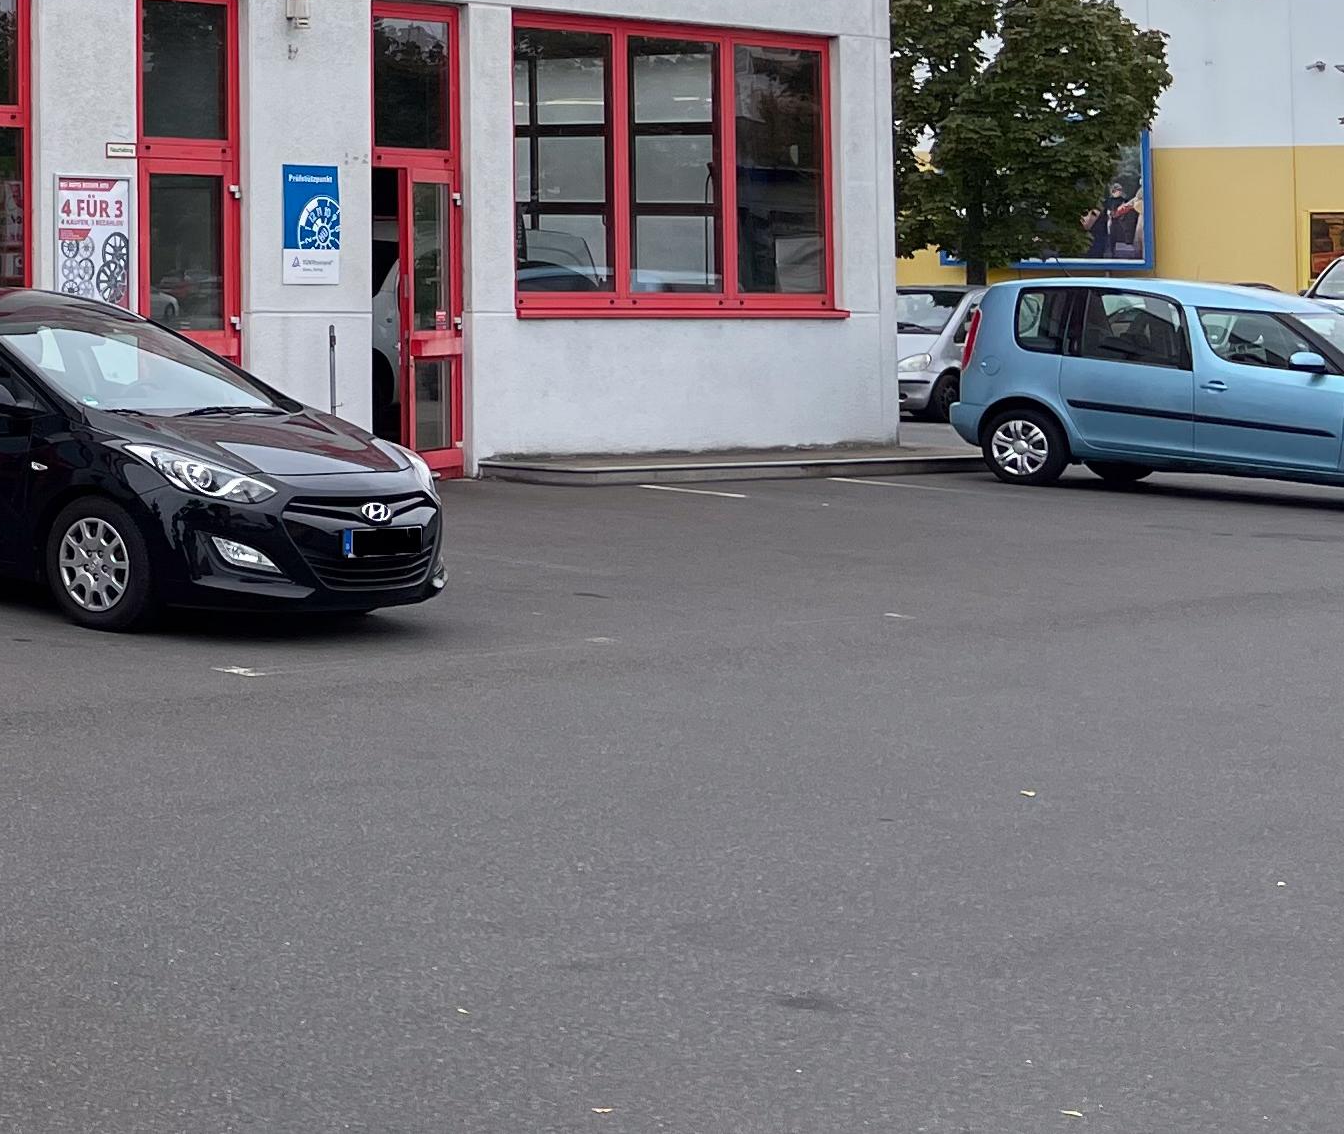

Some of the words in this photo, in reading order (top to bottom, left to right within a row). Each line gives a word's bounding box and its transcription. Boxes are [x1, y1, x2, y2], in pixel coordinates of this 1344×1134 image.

[61, 199, 72, 217] 4
[77, 194, 111, 218] FÜR
[114, 200, 123, 218] 3
